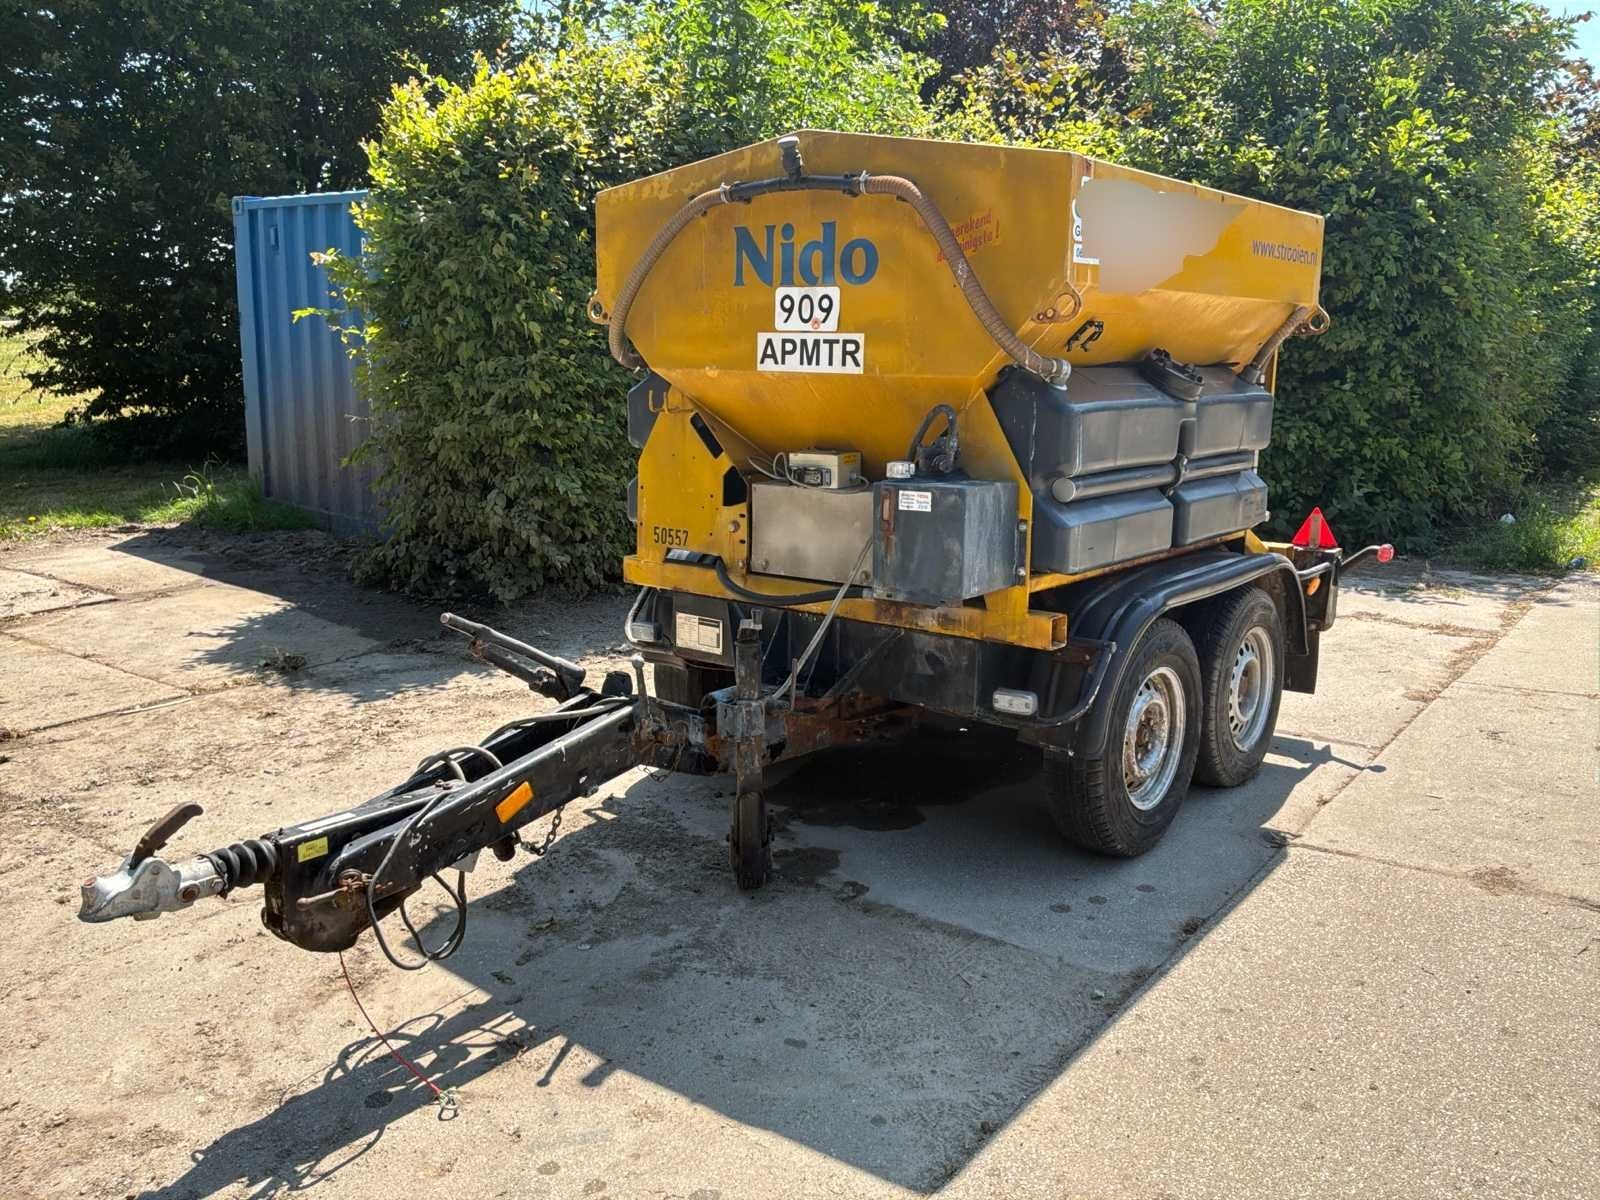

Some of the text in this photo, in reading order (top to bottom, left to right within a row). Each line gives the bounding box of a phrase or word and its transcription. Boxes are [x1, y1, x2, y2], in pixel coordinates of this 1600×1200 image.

[733, 220, 879, 287] Nido
[780, 294, 833, 324] 909
[759, 338, 861, 368] APMTR
[653, 526, 689, 546] 50557
